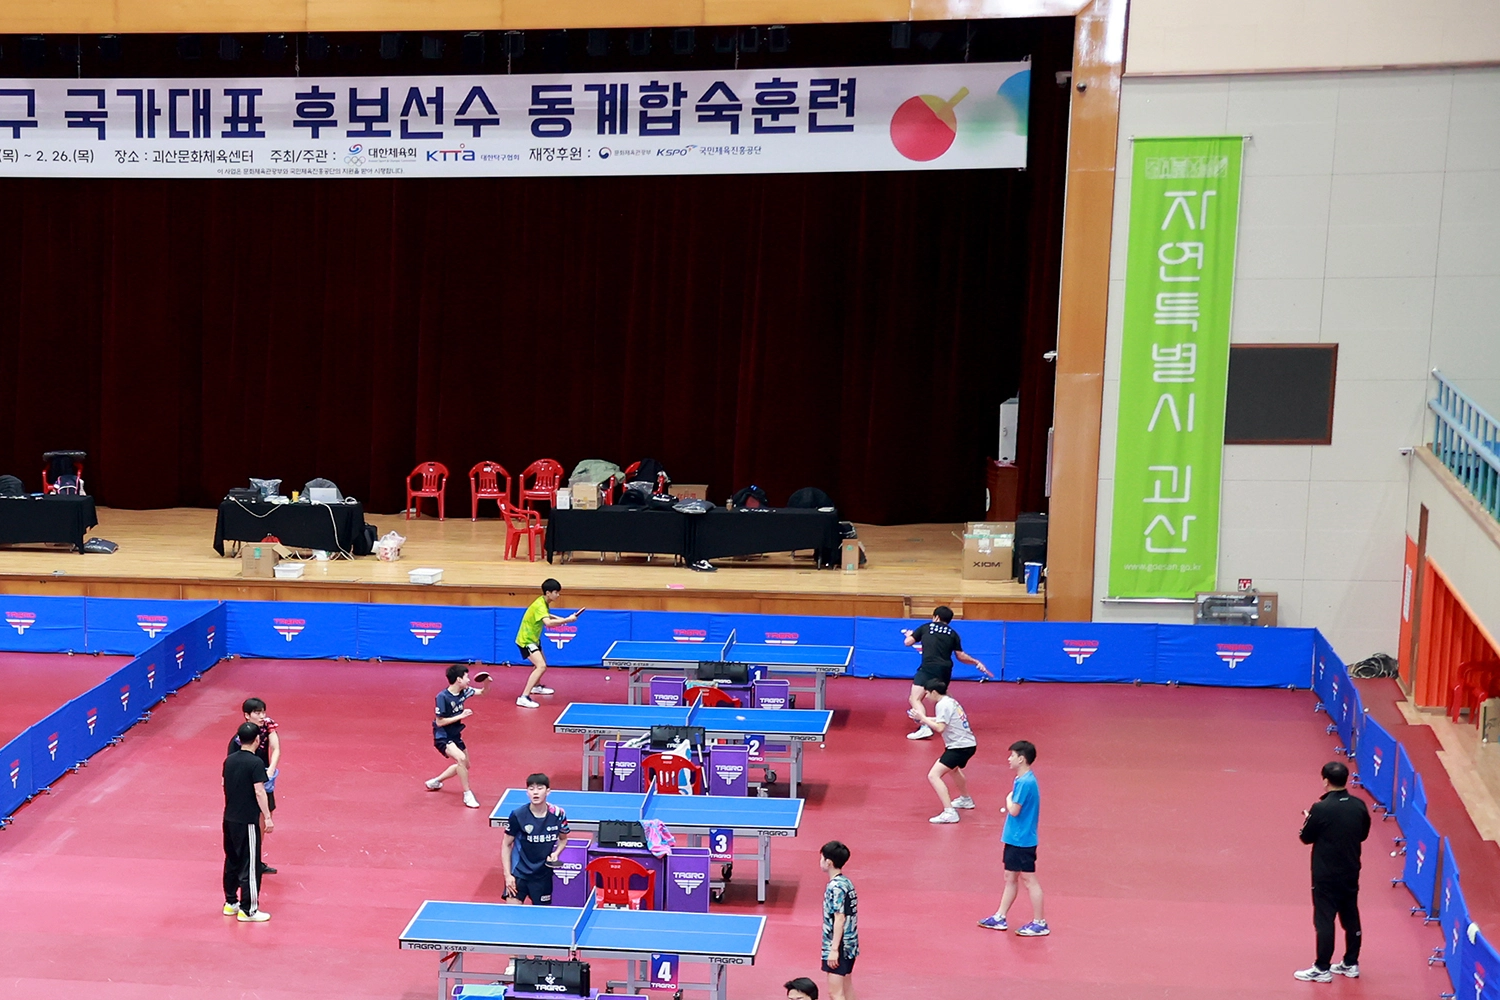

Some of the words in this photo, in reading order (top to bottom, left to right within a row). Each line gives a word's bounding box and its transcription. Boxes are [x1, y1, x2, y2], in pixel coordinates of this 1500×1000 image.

[64, 88, 266, 140] 국가대표
[293, 85, 500, 140] 후보선수
[528, 77, 857, 138] 동계합숙훈련
[52, 149, 95, 164] 26.(목)
[114, 149, 140, 164] 장소
[152, 149, 254, 164] 괴산문화체육센터
[270, 149, 328, 164] 주최/주관
[368, 147, 417, 159] 대한체육회
[528, 147, 582, 162] 재정후원
[656, 148, 688, 157] KSPO
[1146, 190, 1217, 434] 자연특별시
[1143, 464, 1197, 554] 괴산
[749, 739, 760, 756] 2
[715, 834, 728, 853] 3
[673, 871, 705, 879] TAGRO
[657, 961, 672, 982] 4
[534, 984, 567, 992] TAGRO
